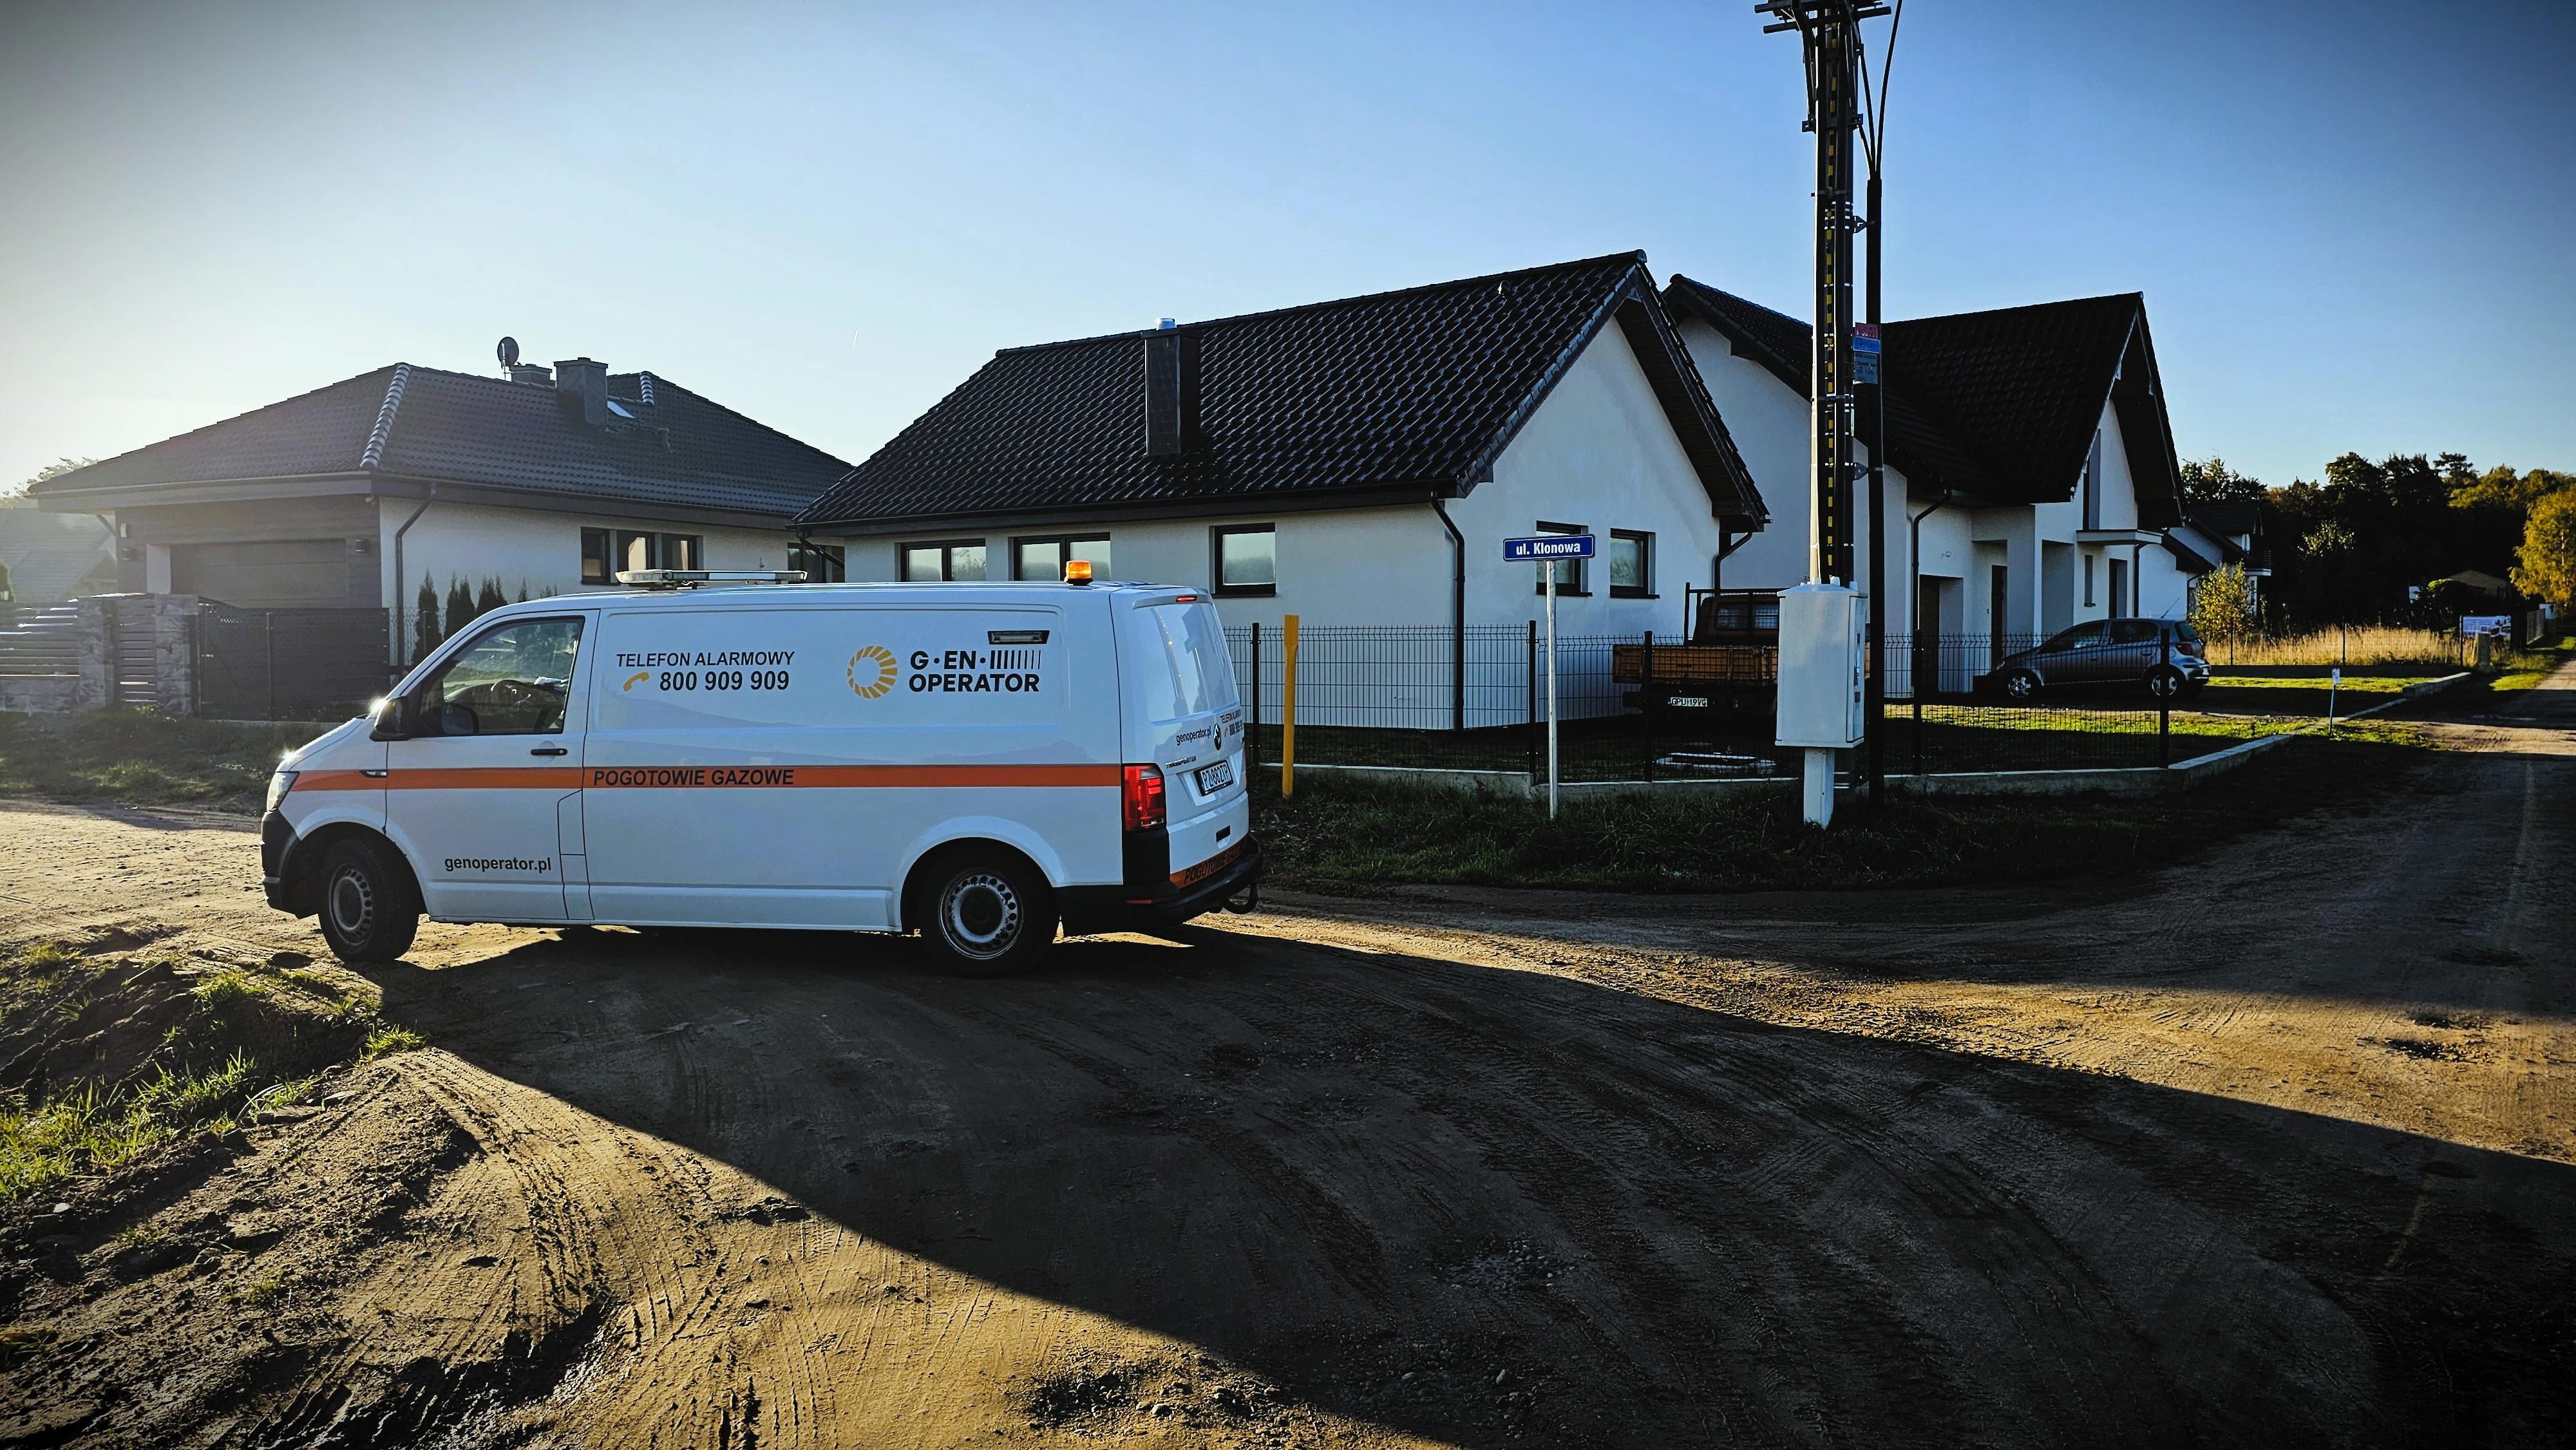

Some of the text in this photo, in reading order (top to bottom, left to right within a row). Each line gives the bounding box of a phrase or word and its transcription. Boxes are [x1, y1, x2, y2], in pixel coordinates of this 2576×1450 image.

[1516, 542, 1581, 556] ul. Klonowa
[616, 651, 795, 667] TELEFON ALARMOWY
[659, 670, 790, 691] 800 909 909
[909, 673, 1040, 693] OPERATOR
[1176, 725, 1212, 746] genoperator.pl
[593, 769, 794, 786] POGOTOWIE GAZOWE
[444, 857, 552, 874] genoperator.pl
